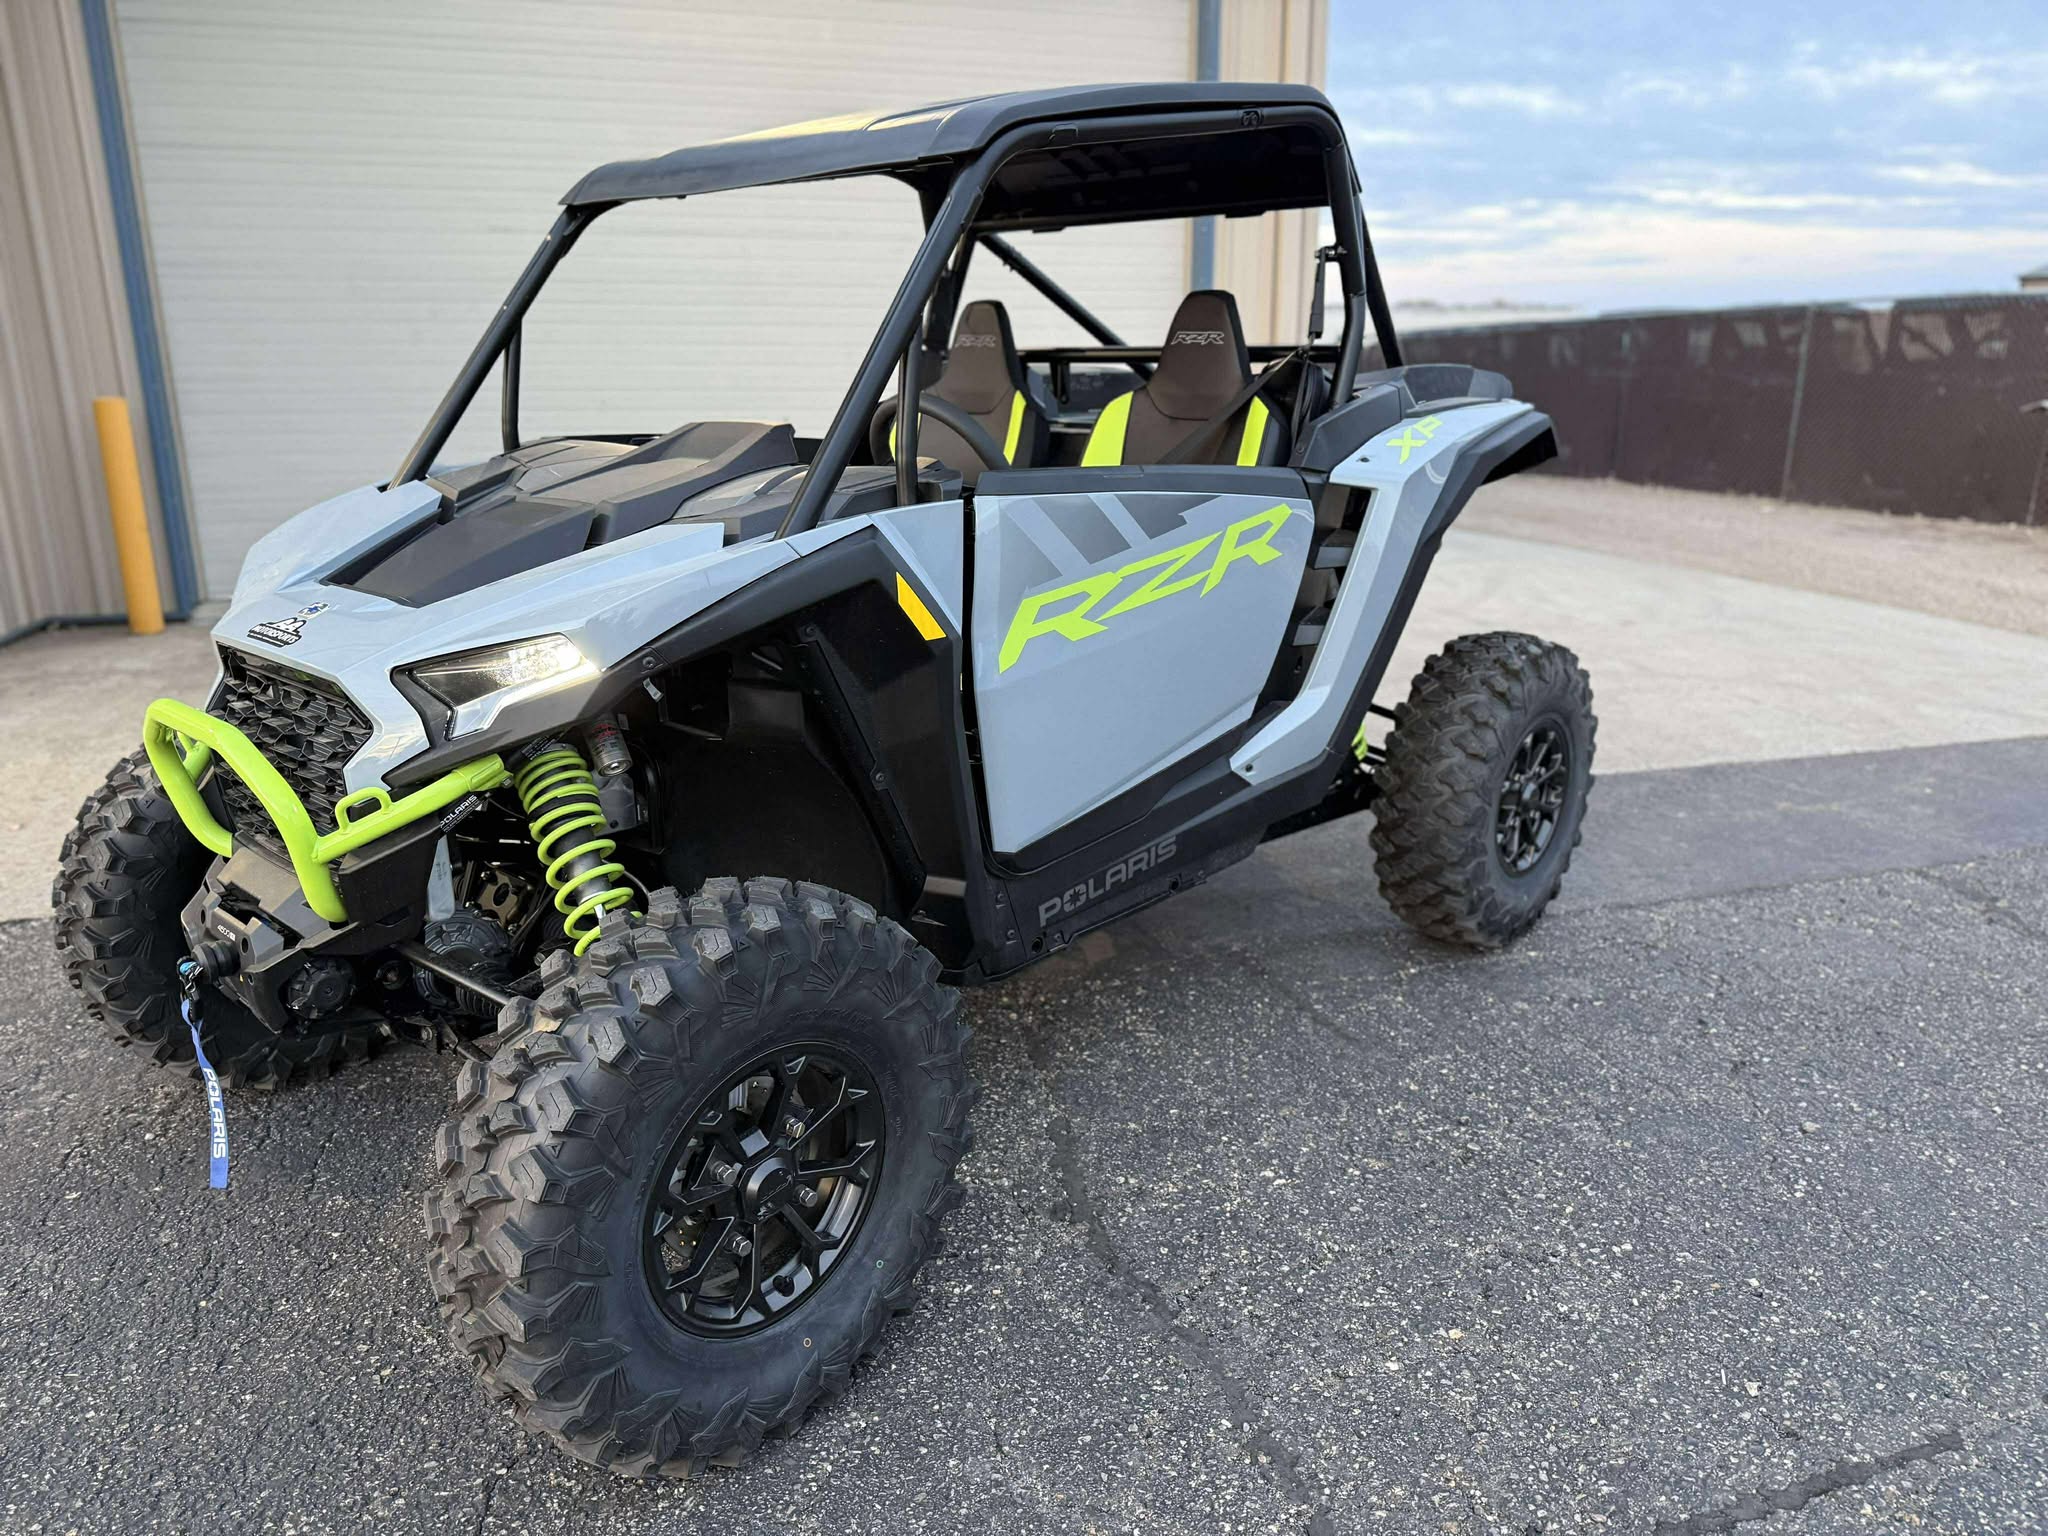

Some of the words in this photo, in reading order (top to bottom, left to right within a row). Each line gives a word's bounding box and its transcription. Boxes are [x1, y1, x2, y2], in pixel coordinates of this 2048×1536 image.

[1171, 331, 1225, 345] RZR
[1385, 415, 1443, 465] XP
[998, 503, 1293, 674] RZR
[250, 624, 301, 643] MOTORSPORTS
[440, 794, 478, 829] POLARIS
[1038, 834, 1177, 928] POLARIS
[202, 1067, 227, 1159] POLARIS
